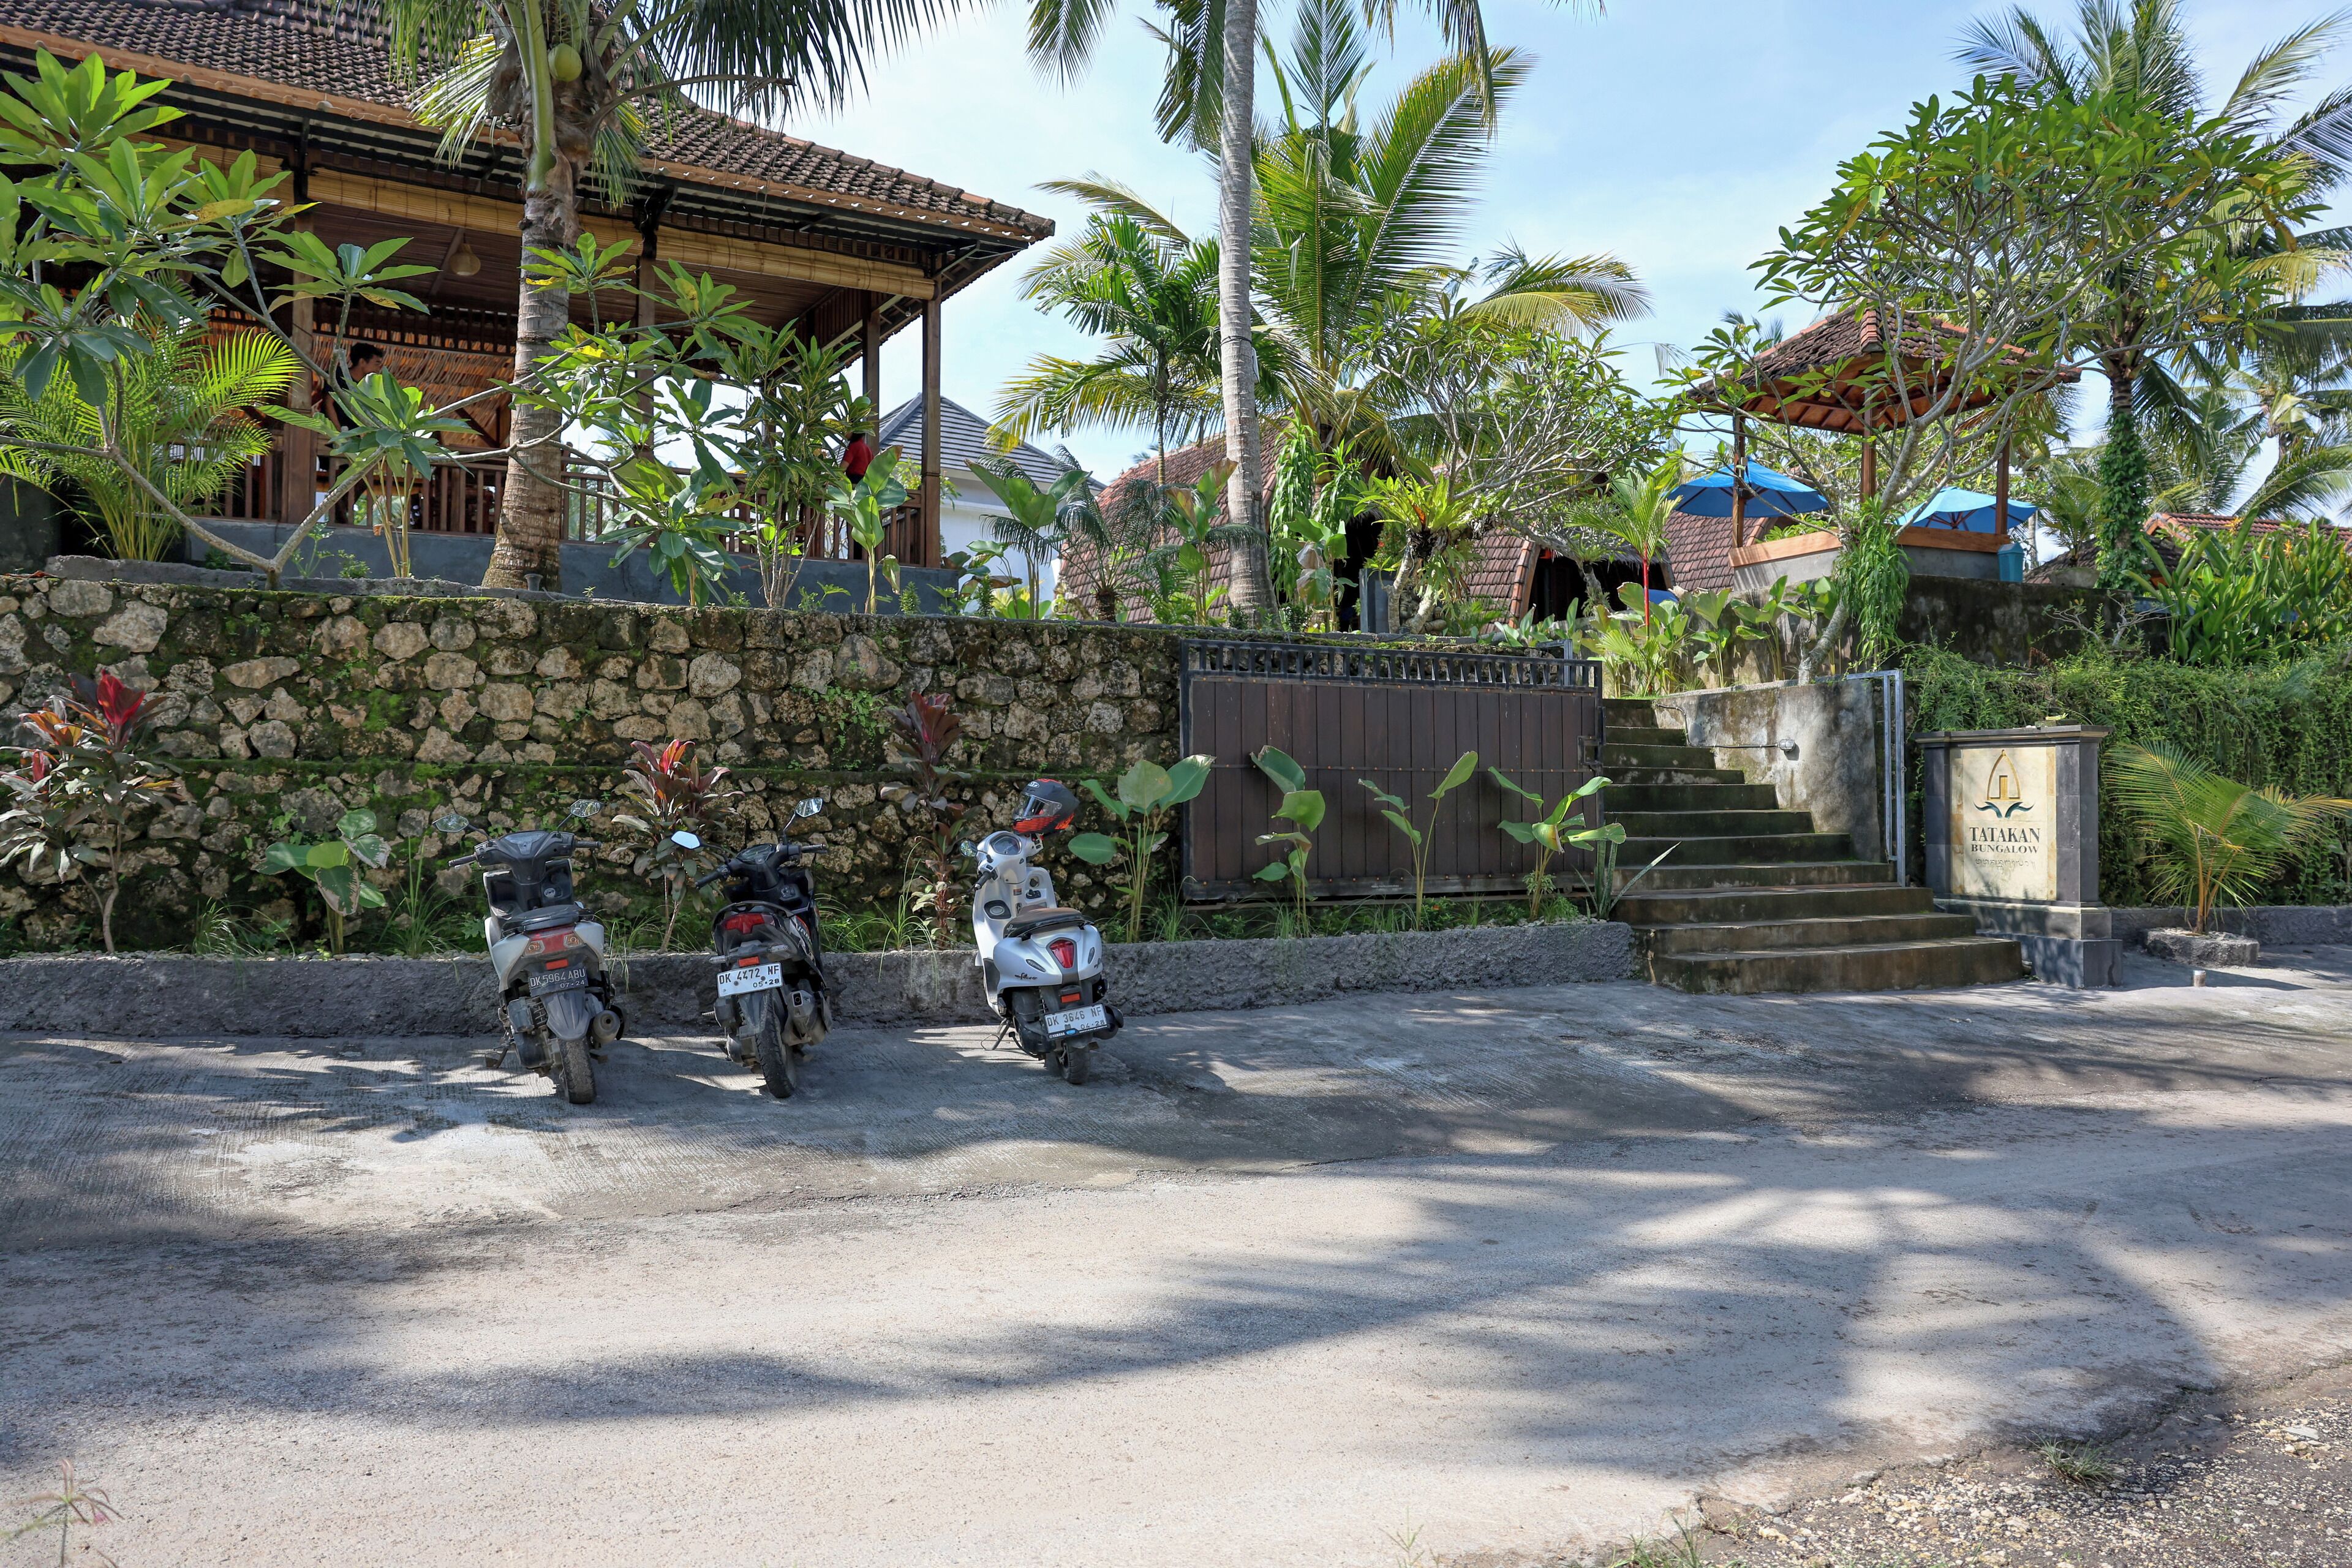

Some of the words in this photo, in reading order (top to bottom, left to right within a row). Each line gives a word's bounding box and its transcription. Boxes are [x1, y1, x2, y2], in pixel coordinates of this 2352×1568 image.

[1969, 827, 2041, 843] TATAKAN
[1972, 844, 2039, 854] BUNGALOW
[530, 976, 542, 987] DK
[543, 971, 566, 984] 5964
[568, 968, 586, 979] ABU
[719, 973, 731, 984] DK
[737, 968, 761, 980] 4472
[767, 965, 779, 975] NF
[1047, 1016, 1059, 1027] DK
[1063, 1011, 1085, 1023] 3646
[1090, 1006, 1102, 1017] NF
